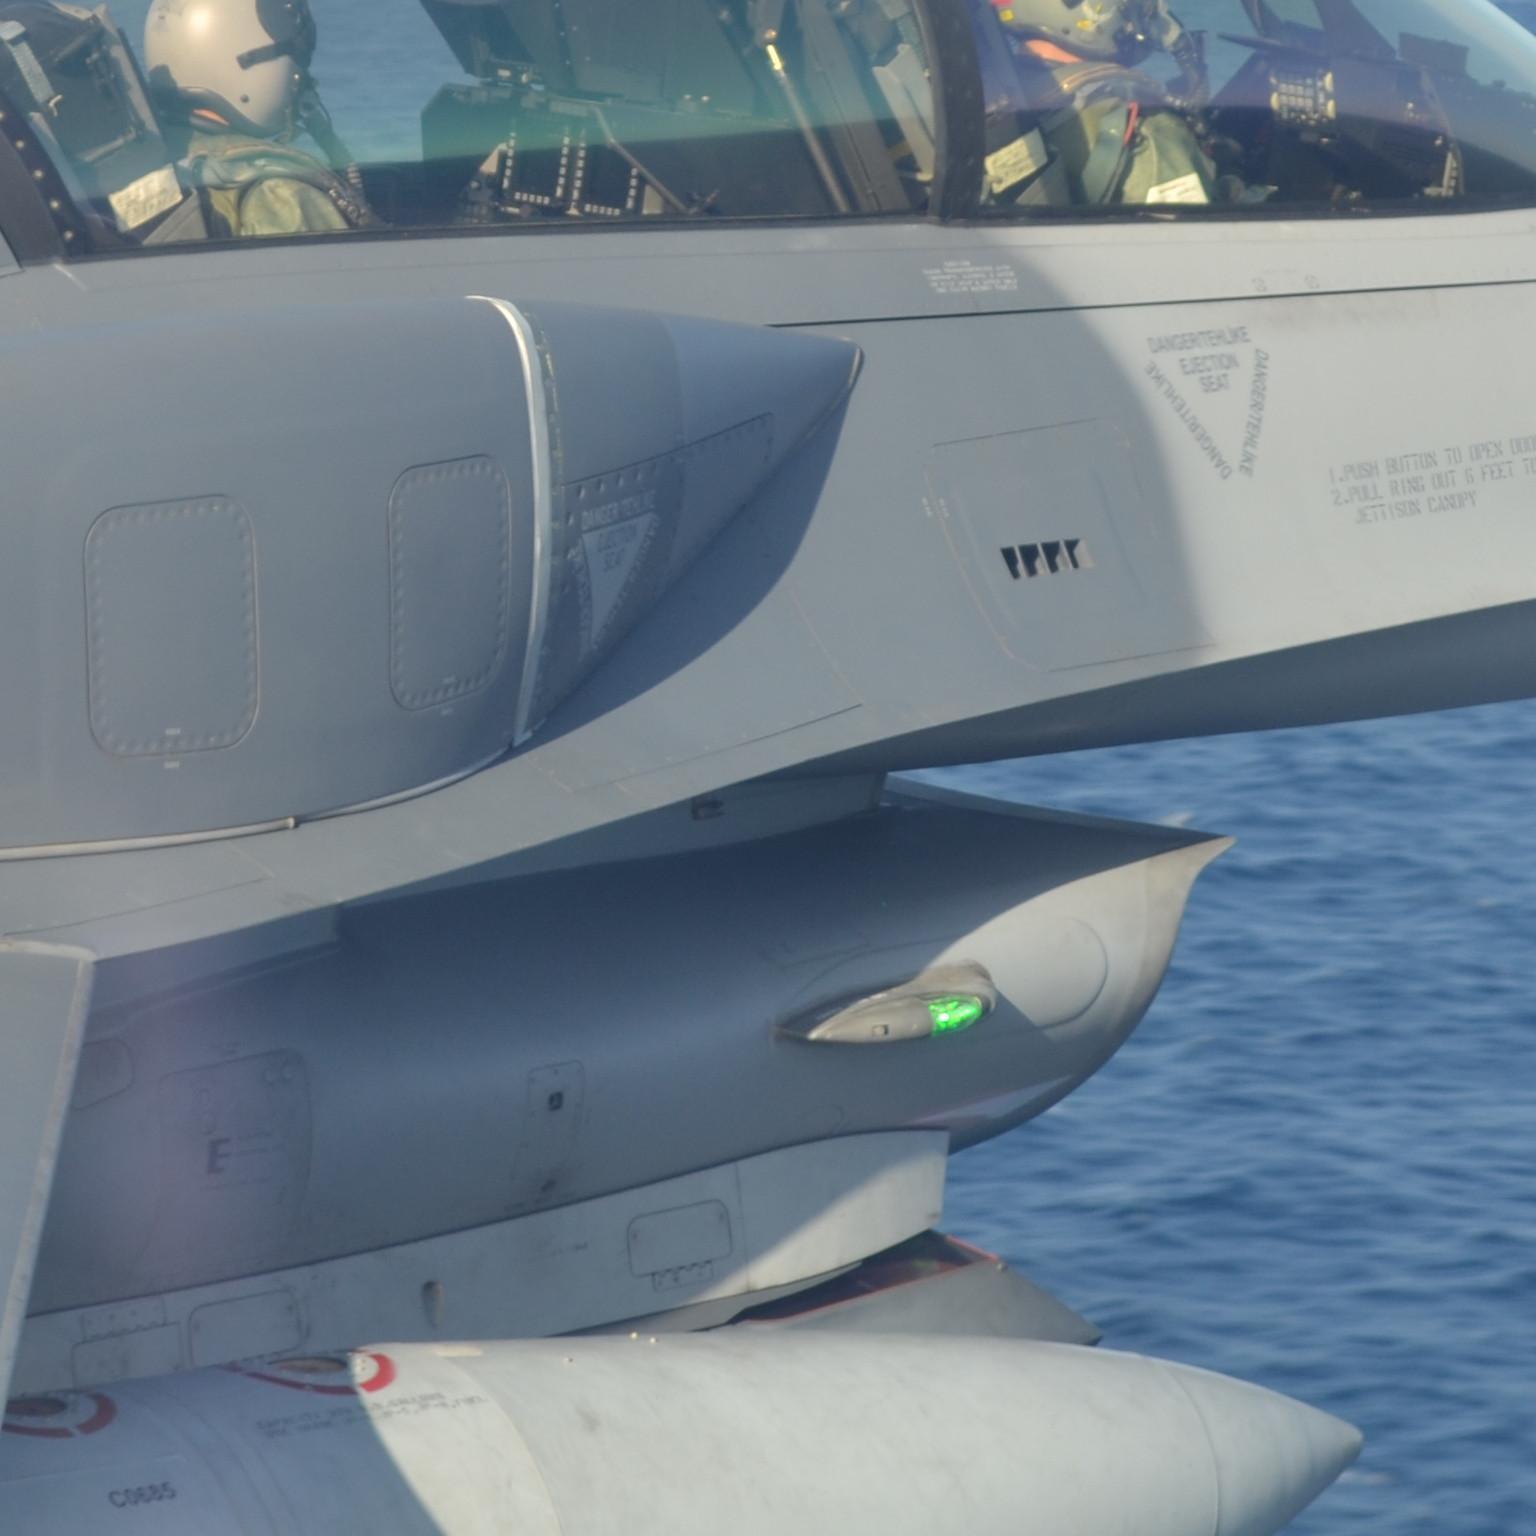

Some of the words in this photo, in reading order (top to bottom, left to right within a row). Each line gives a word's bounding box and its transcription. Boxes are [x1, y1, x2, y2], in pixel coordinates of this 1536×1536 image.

[1178, 353, 1240, 376] EJECTION
[1197, 372, 1230, 394] SEAT
[1385, 451, 1438, 476] BUTTON
[1444, 447, 1462, 465] TO
[1389, 475, 1425, 497] RING
[1431, 469, 1456, 490] OUT
[1481, 460, 1514, 482] FEET
[1356, 499, 1422, 524] JETTISON
[1427, 490, 1477, 513] CANOPY
